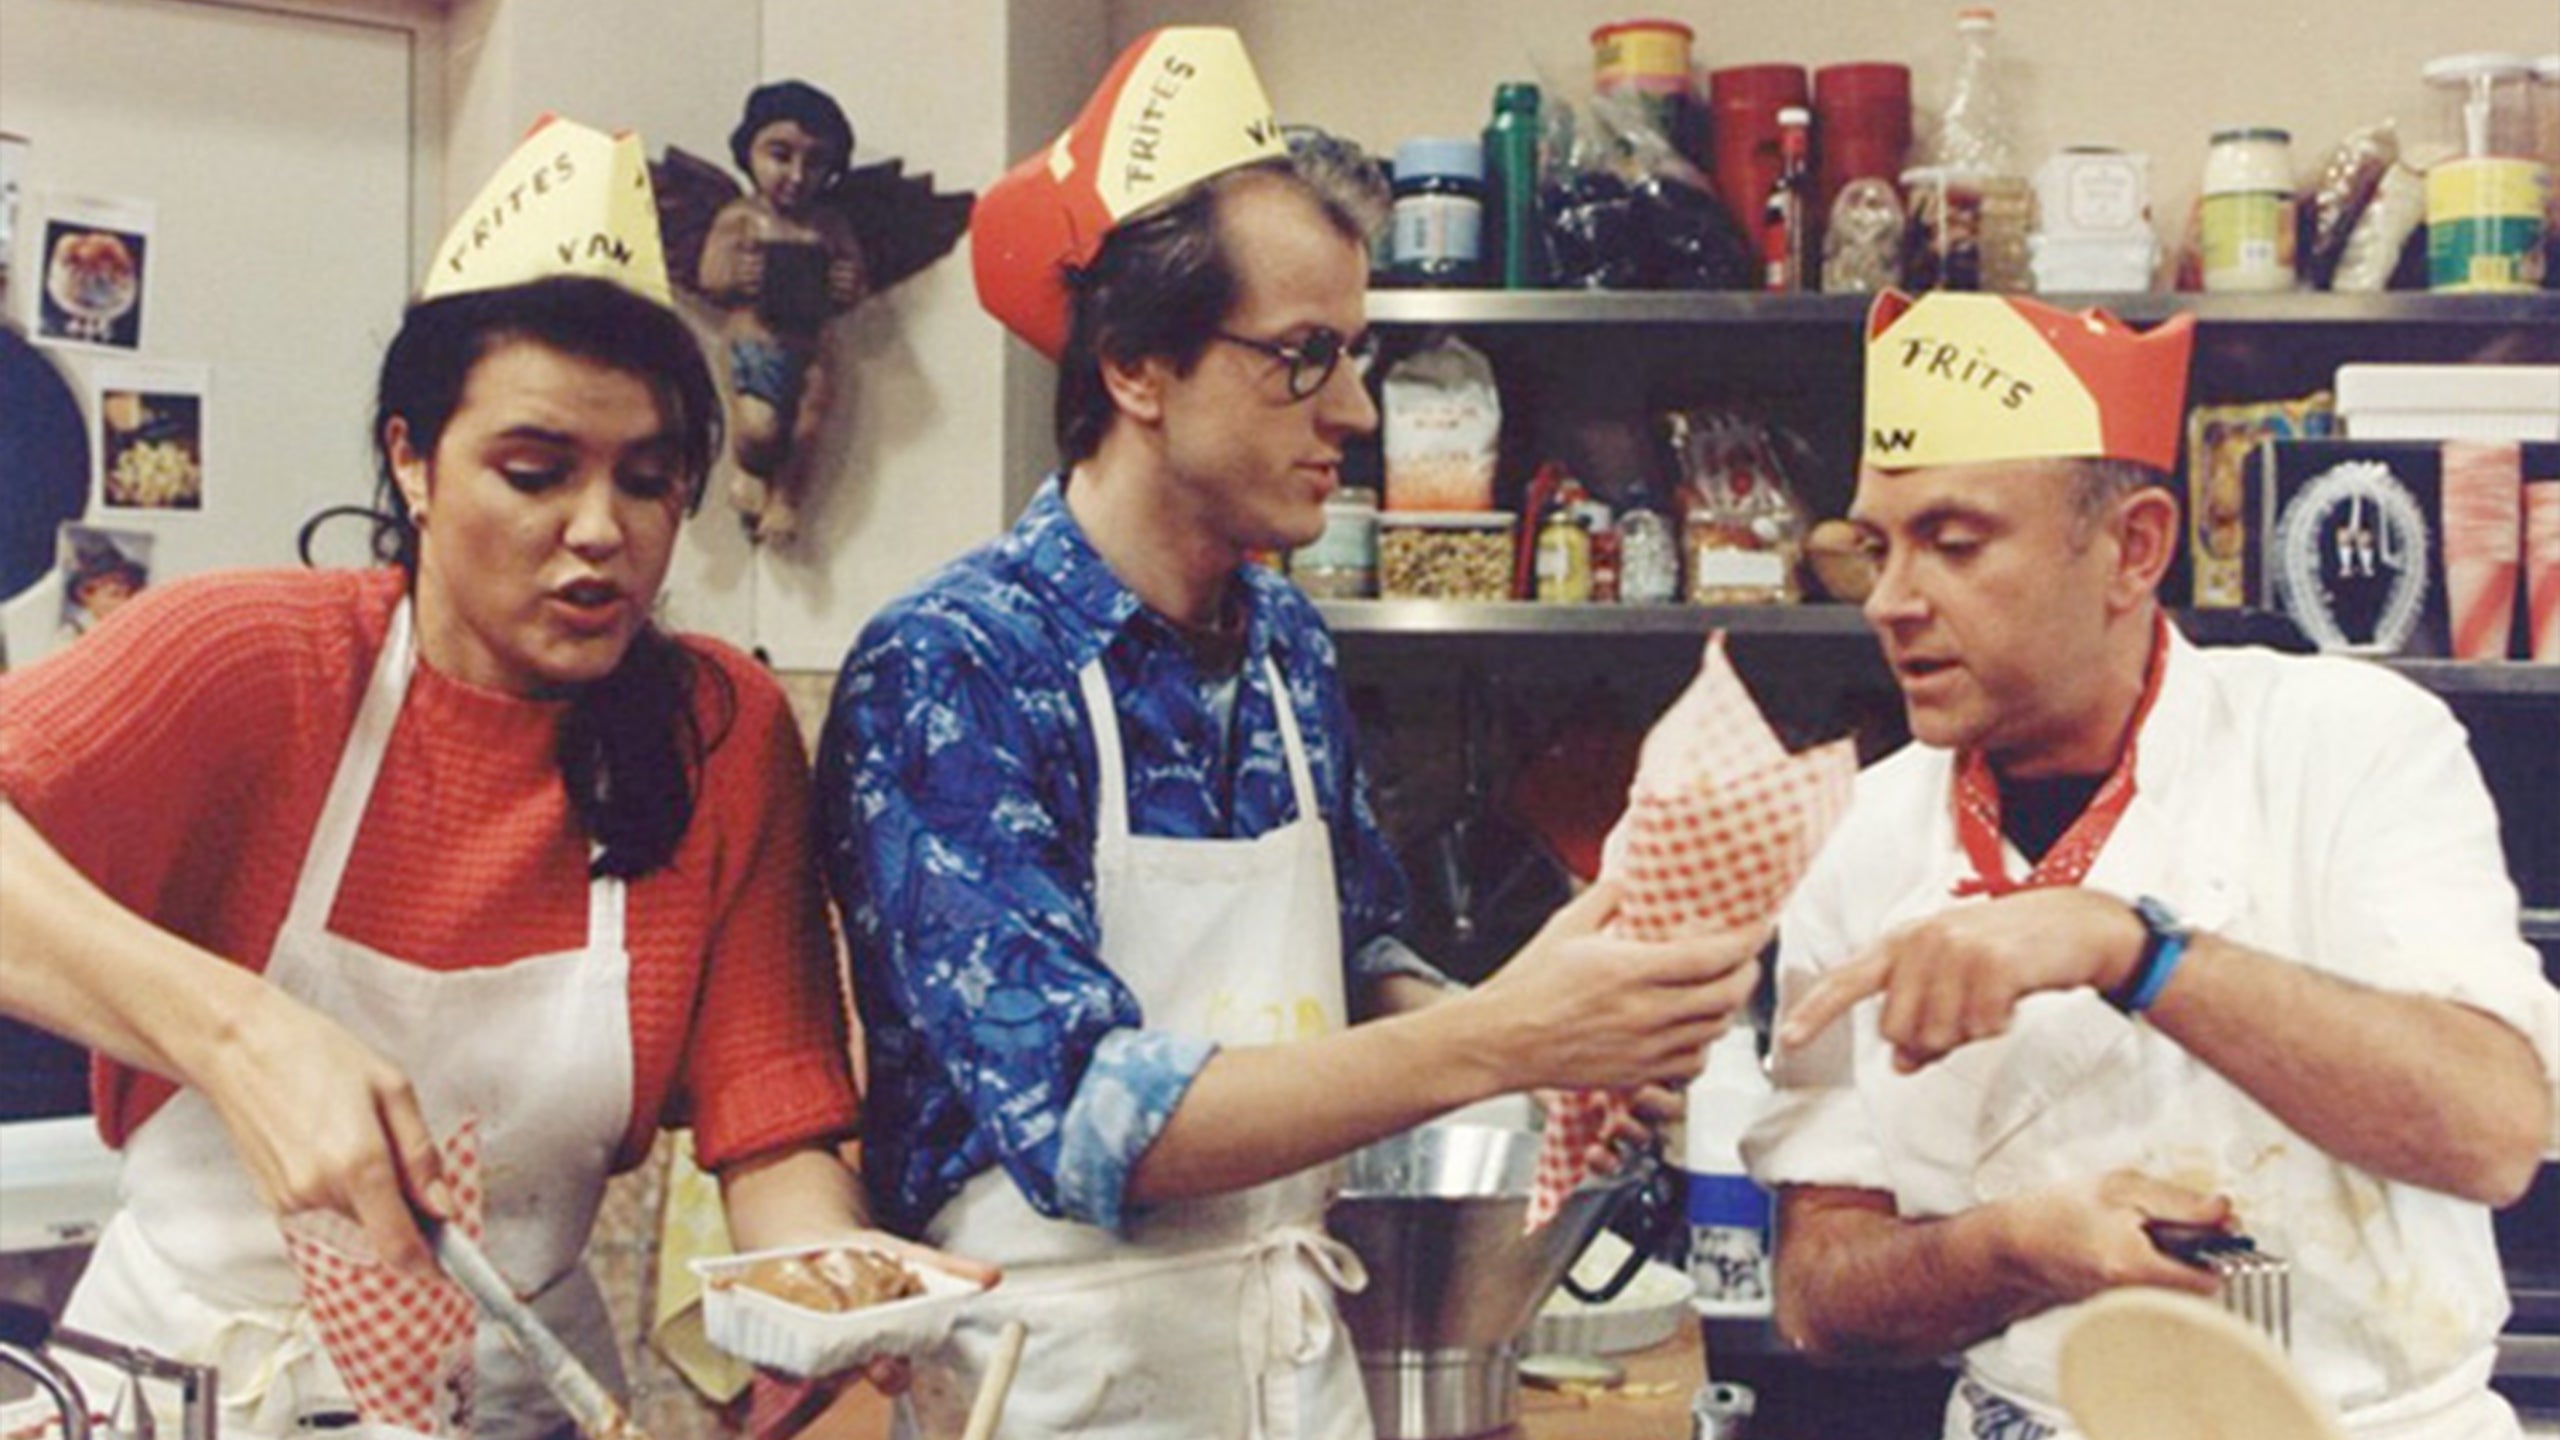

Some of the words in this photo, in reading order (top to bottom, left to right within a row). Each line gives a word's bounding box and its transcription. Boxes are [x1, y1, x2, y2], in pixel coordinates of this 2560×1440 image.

[1244, 115, 1279, 147] V
[557, 232, 635, 266] VAN
[1871, 427, 1918, 454] AN
